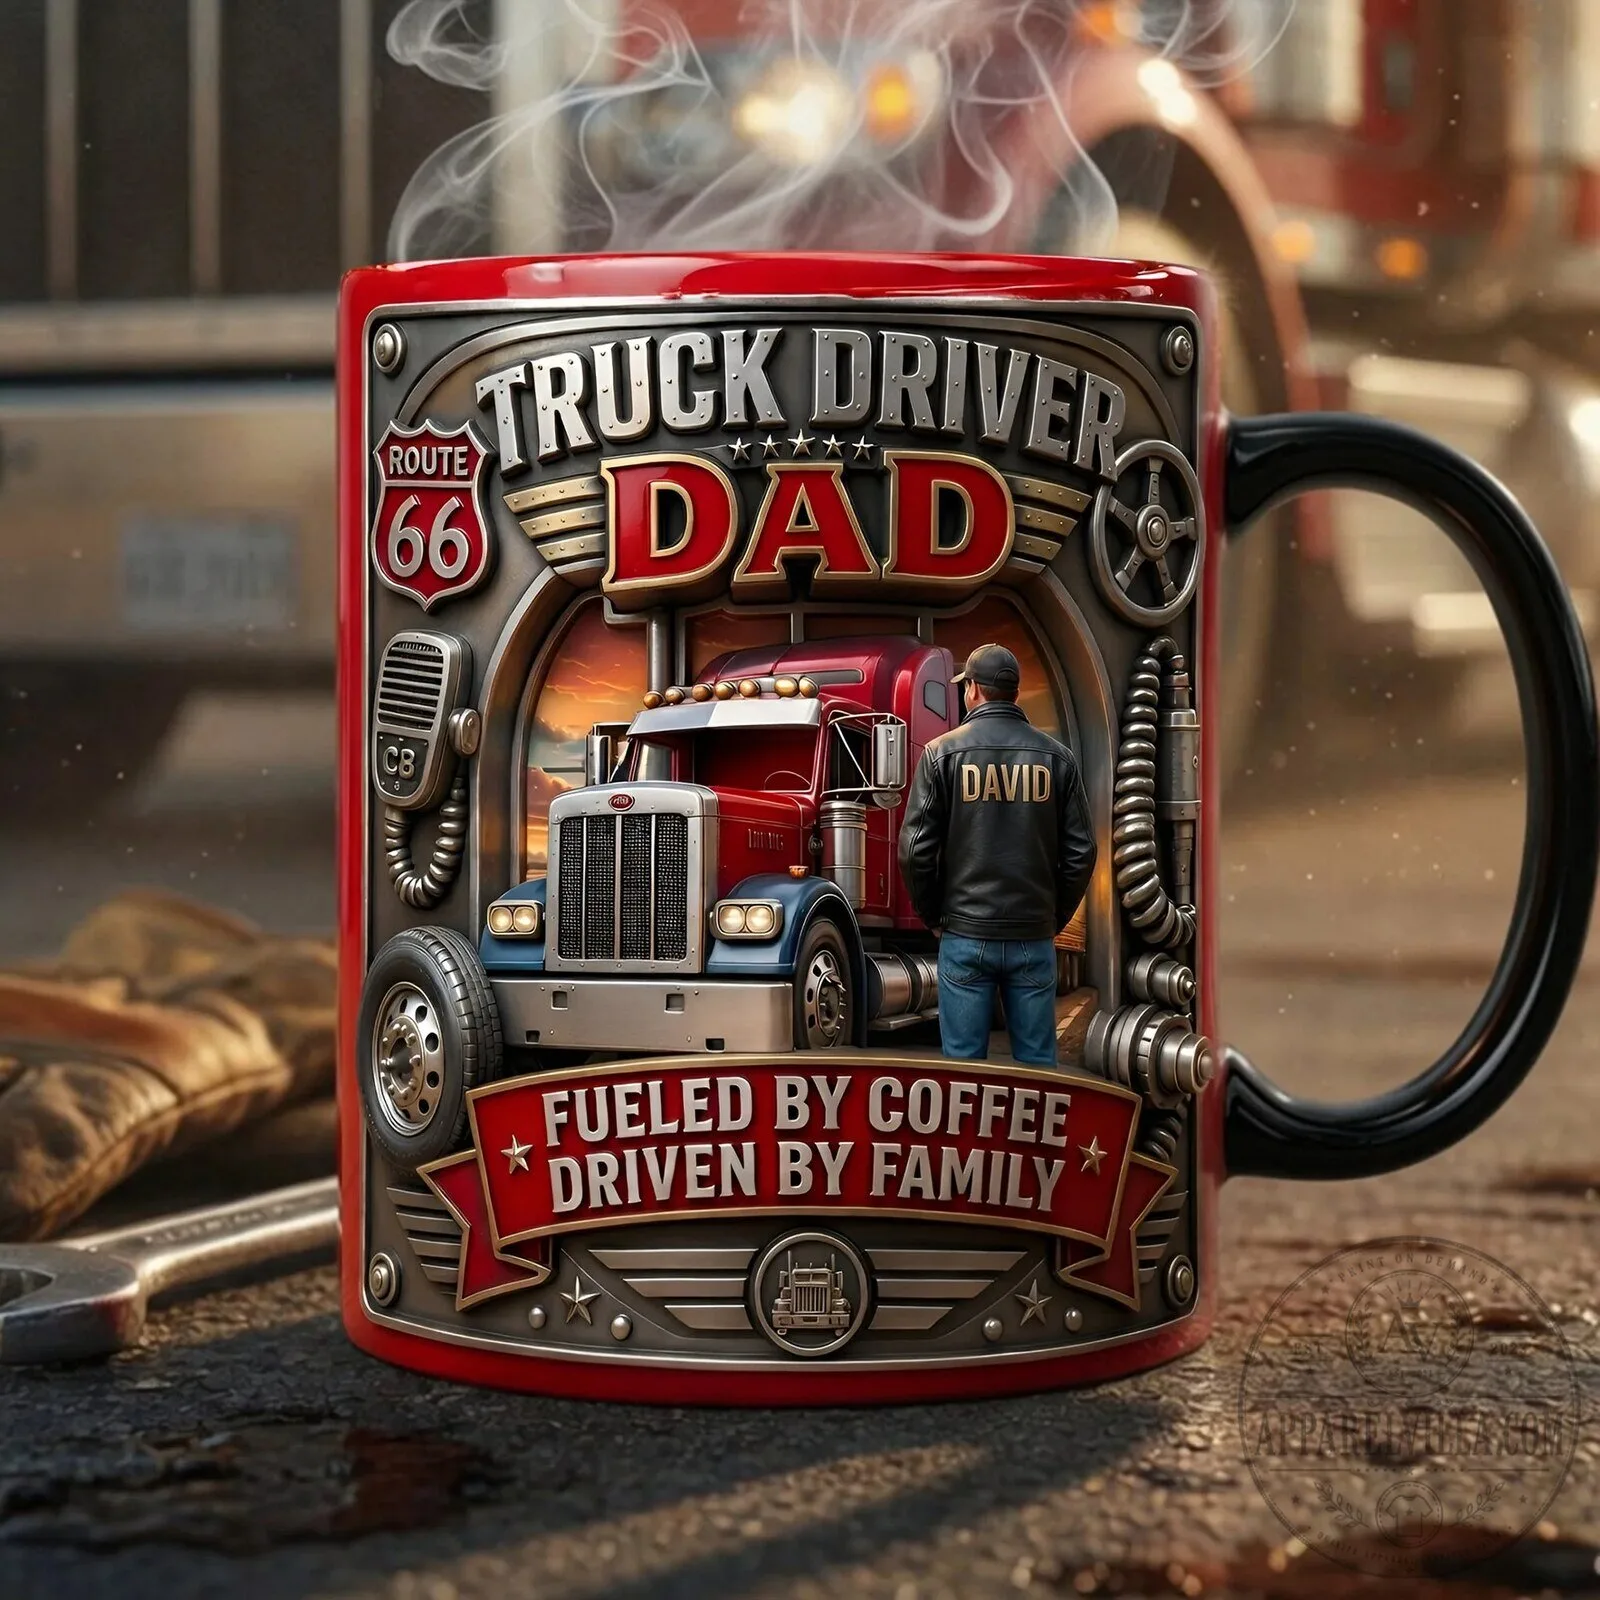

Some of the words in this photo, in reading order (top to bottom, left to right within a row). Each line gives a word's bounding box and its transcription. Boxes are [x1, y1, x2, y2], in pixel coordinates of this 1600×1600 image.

[475, 327, 788, 478] TRUCK
[810, 328, 1126, 483] DRIVER
[389, 445, 469, 477] ROUTE
[388, 495, 469, 579] 66
[600, 449, 1016, 597] DAD
[383, 746, 416, 779] CB
[961, 764, 1051, 802] DAVID
[542, 1076, 753, 1147] FUELED
[774, 1075, 852, 1130] BY
[868, 1076, 1071, 1147] COFFEE
[548, 1141, 756, 1213] DRIVEN
[777, 1141, 854, 1196] BY
[870, 1142, 1066, 1212] FAMILY
